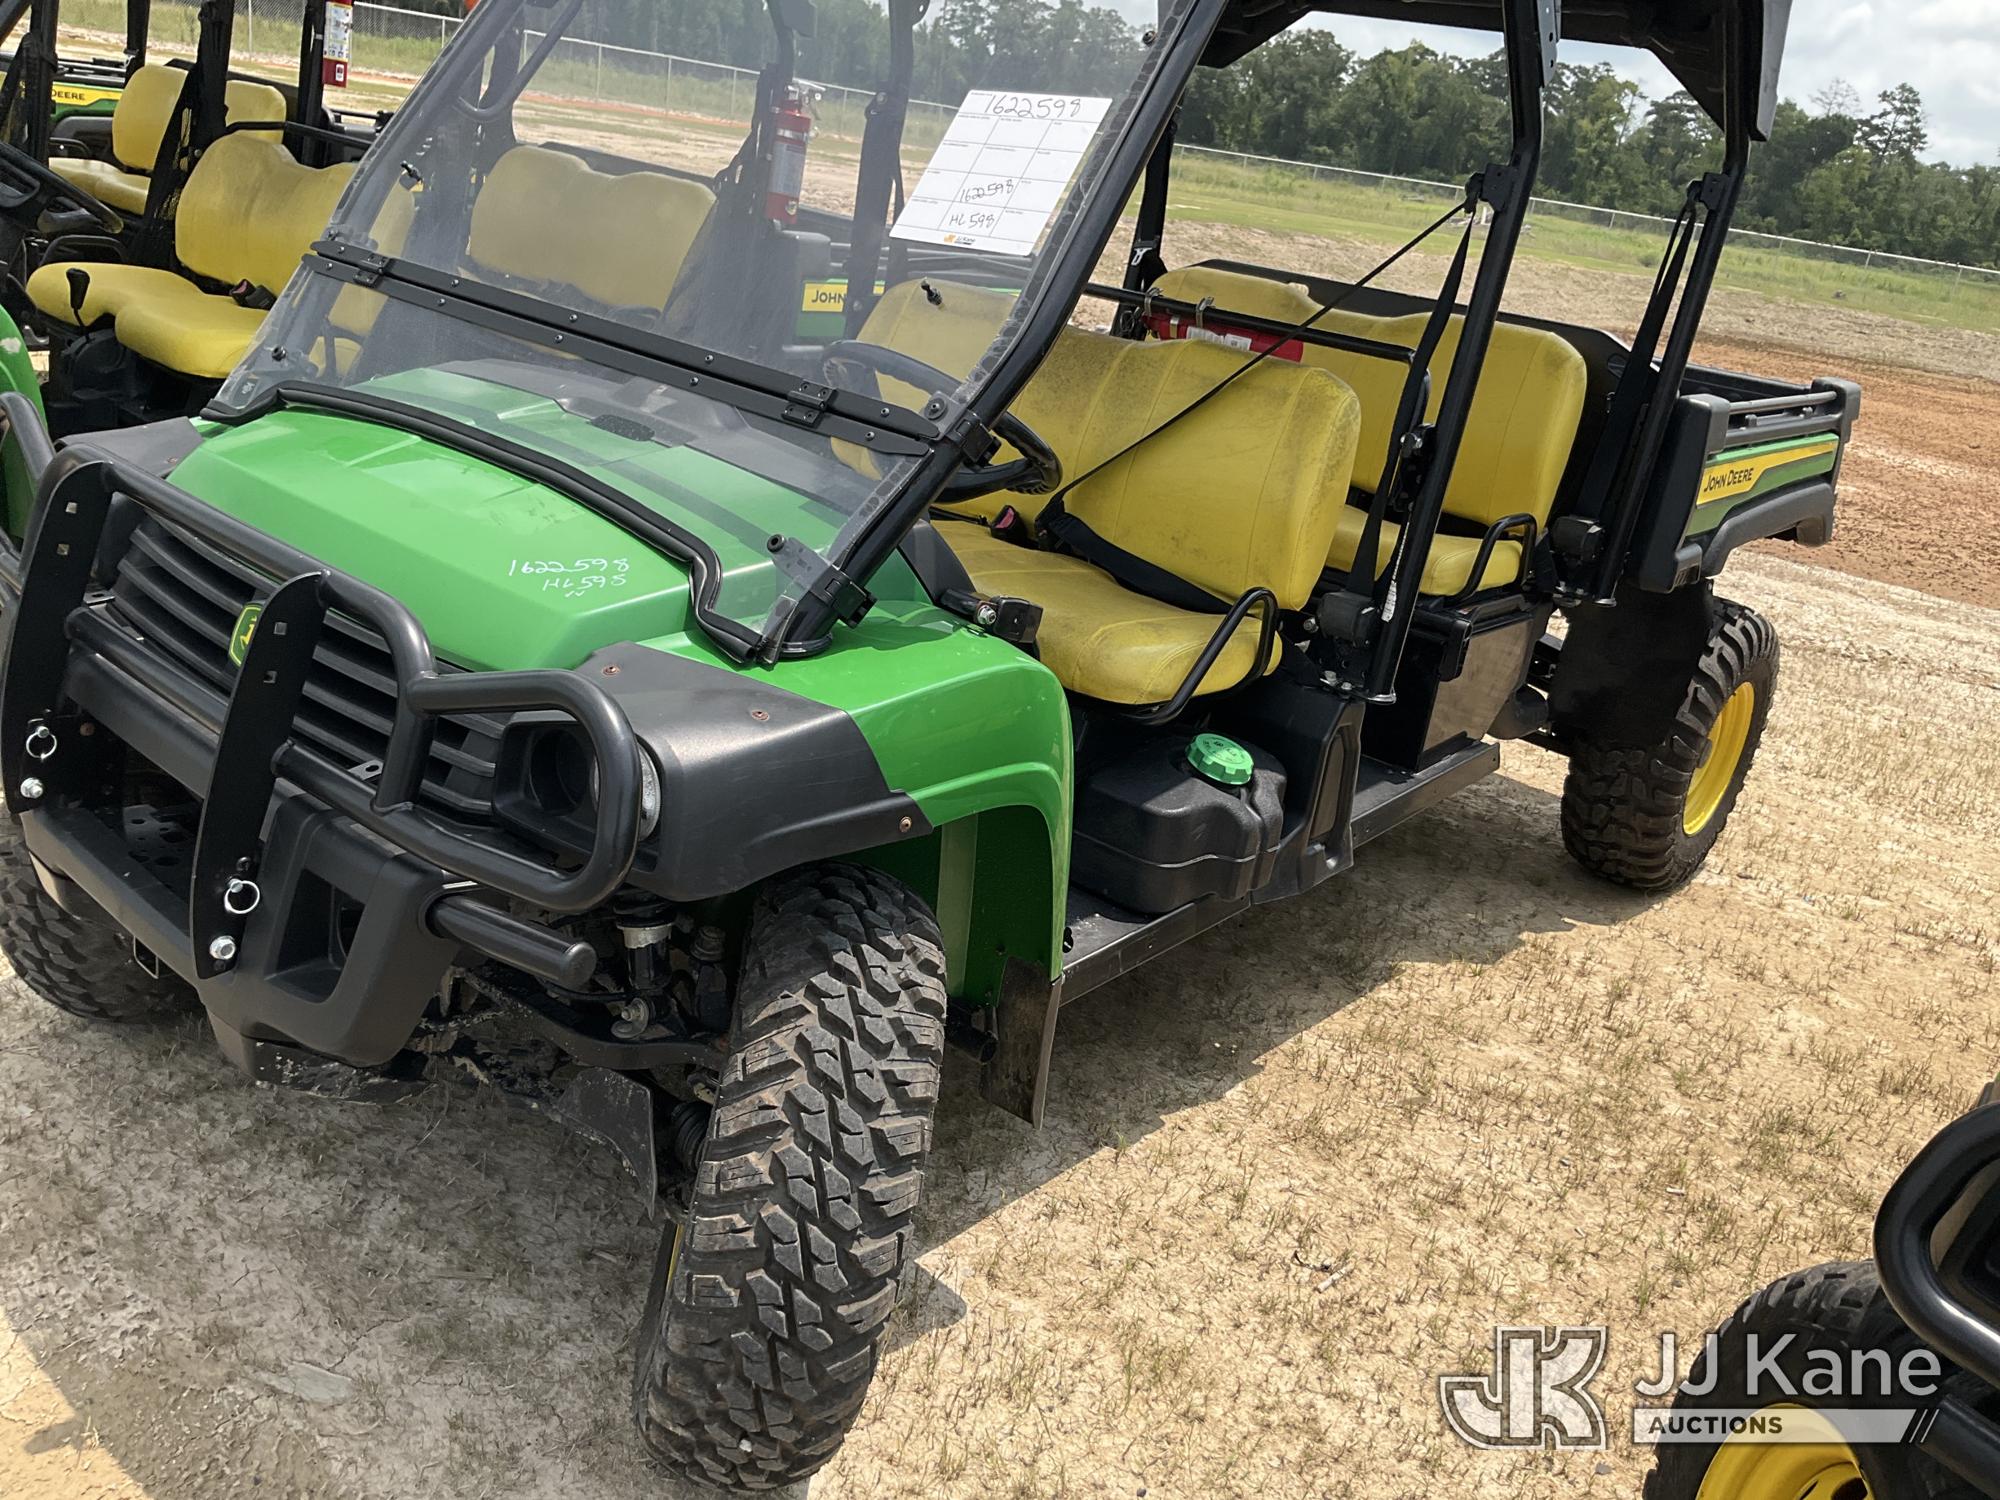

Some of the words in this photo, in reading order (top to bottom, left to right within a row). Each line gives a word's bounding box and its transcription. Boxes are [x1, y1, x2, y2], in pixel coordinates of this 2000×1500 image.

[984, 94, 1081, 119] 1622598
[959, 179, 1014, 203] 1622598
[969, 212, 995, 229] 598
[1703, 474, 1727, 492] JOHN
[1727, 467, 1754, 486] DEERE
[508, 558, 630, 576] 1622598
